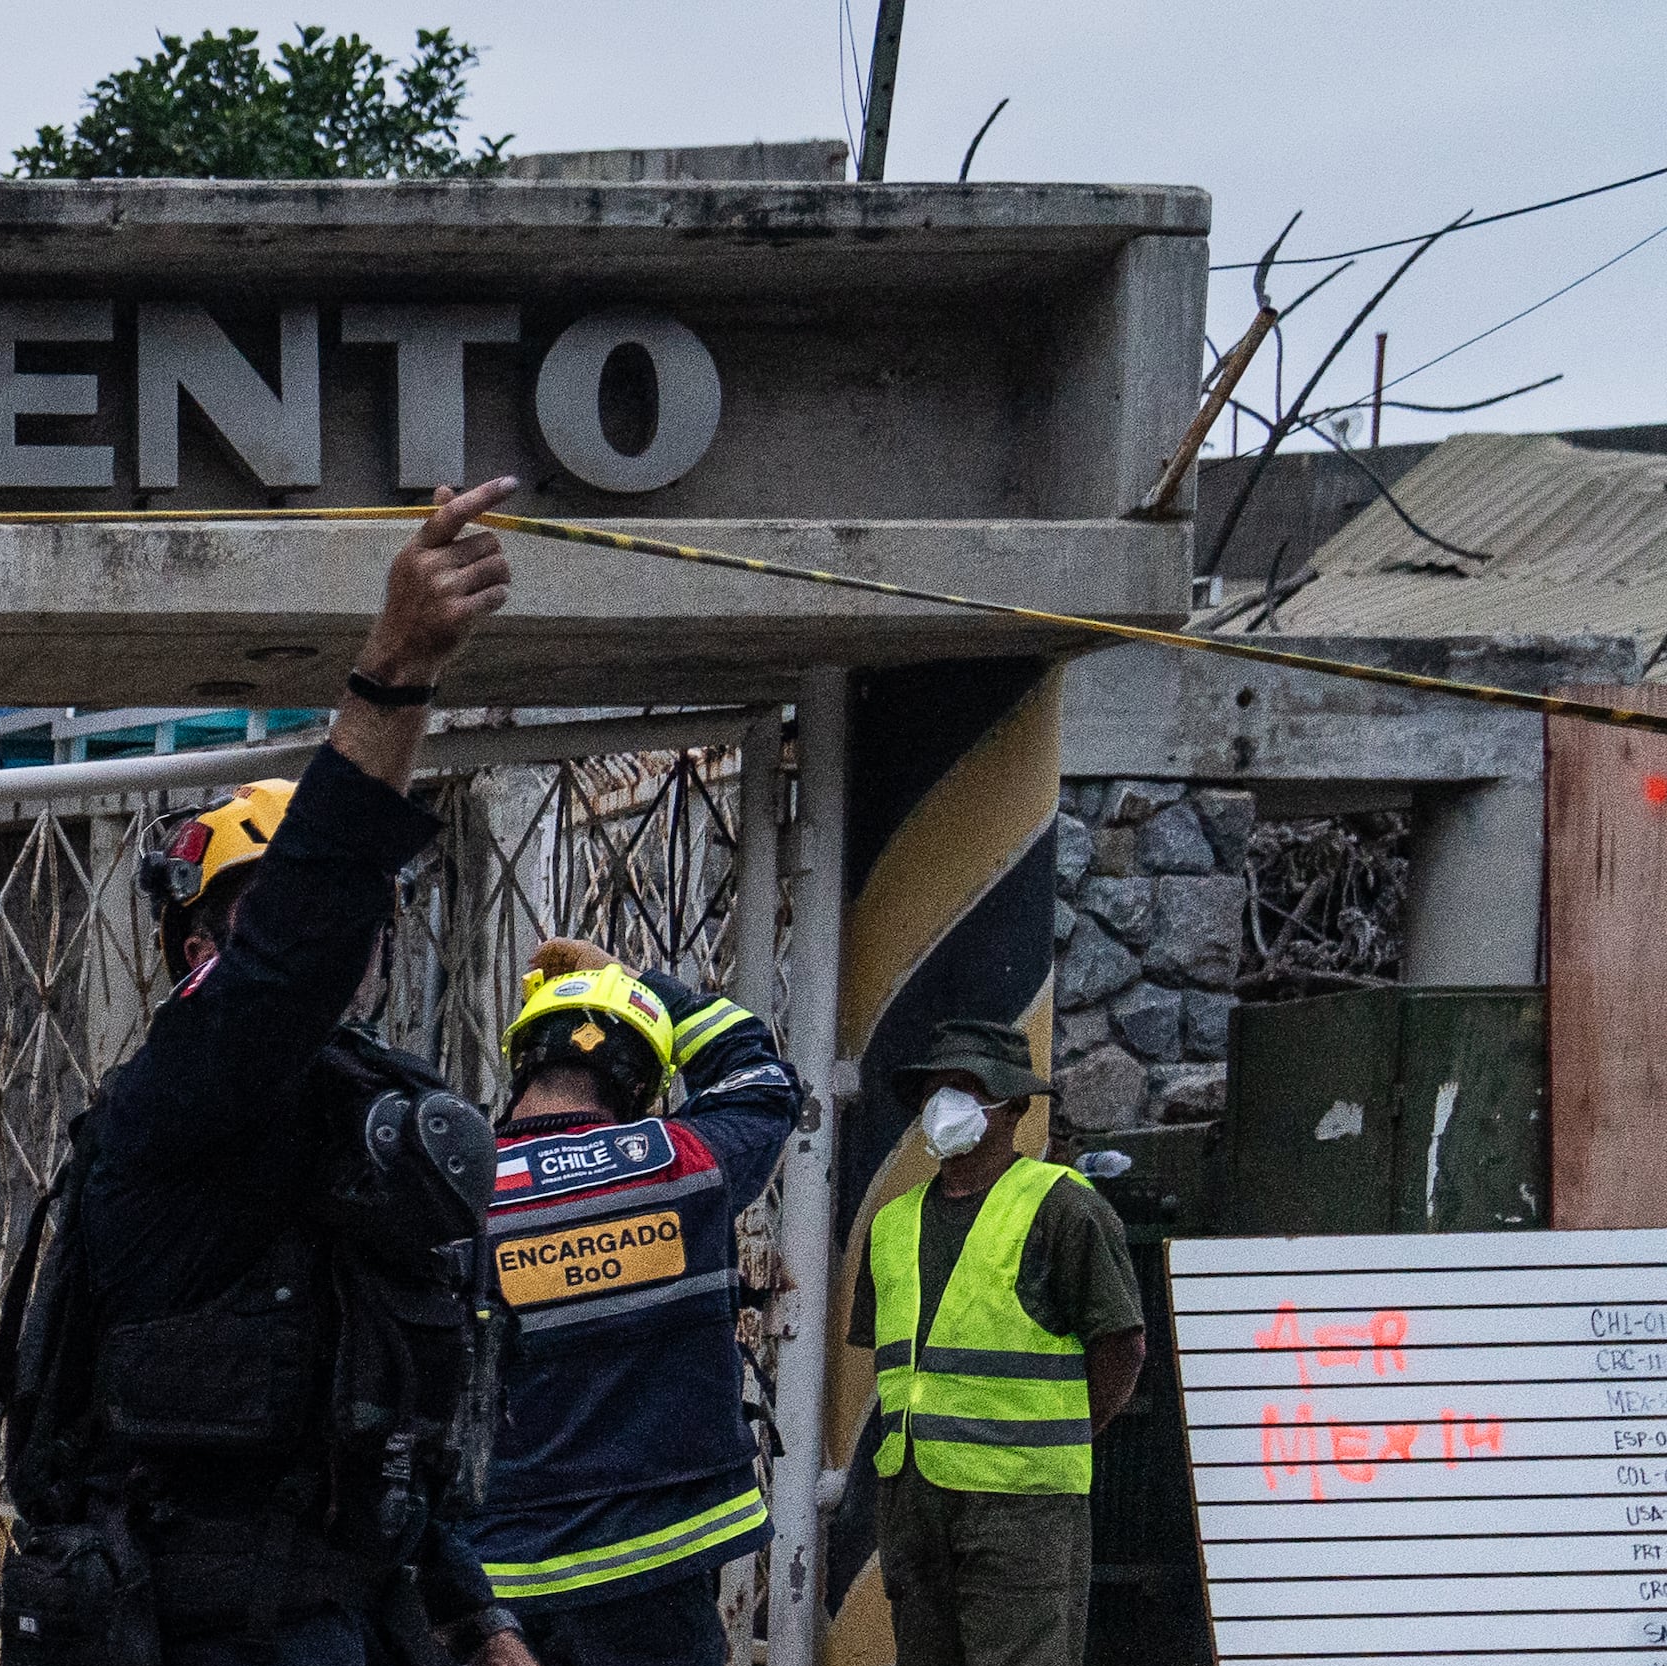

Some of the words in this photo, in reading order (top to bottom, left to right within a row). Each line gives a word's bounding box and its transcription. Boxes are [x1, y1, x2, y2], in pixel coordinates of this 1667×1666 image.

[540, 1147, 612, 1175] CHILE
[500, 1221, 678, 1271] ENCARGADO
[565, 1259, 621, 1286] BoO
[1617, 1465, 1667, 1487] COL-
